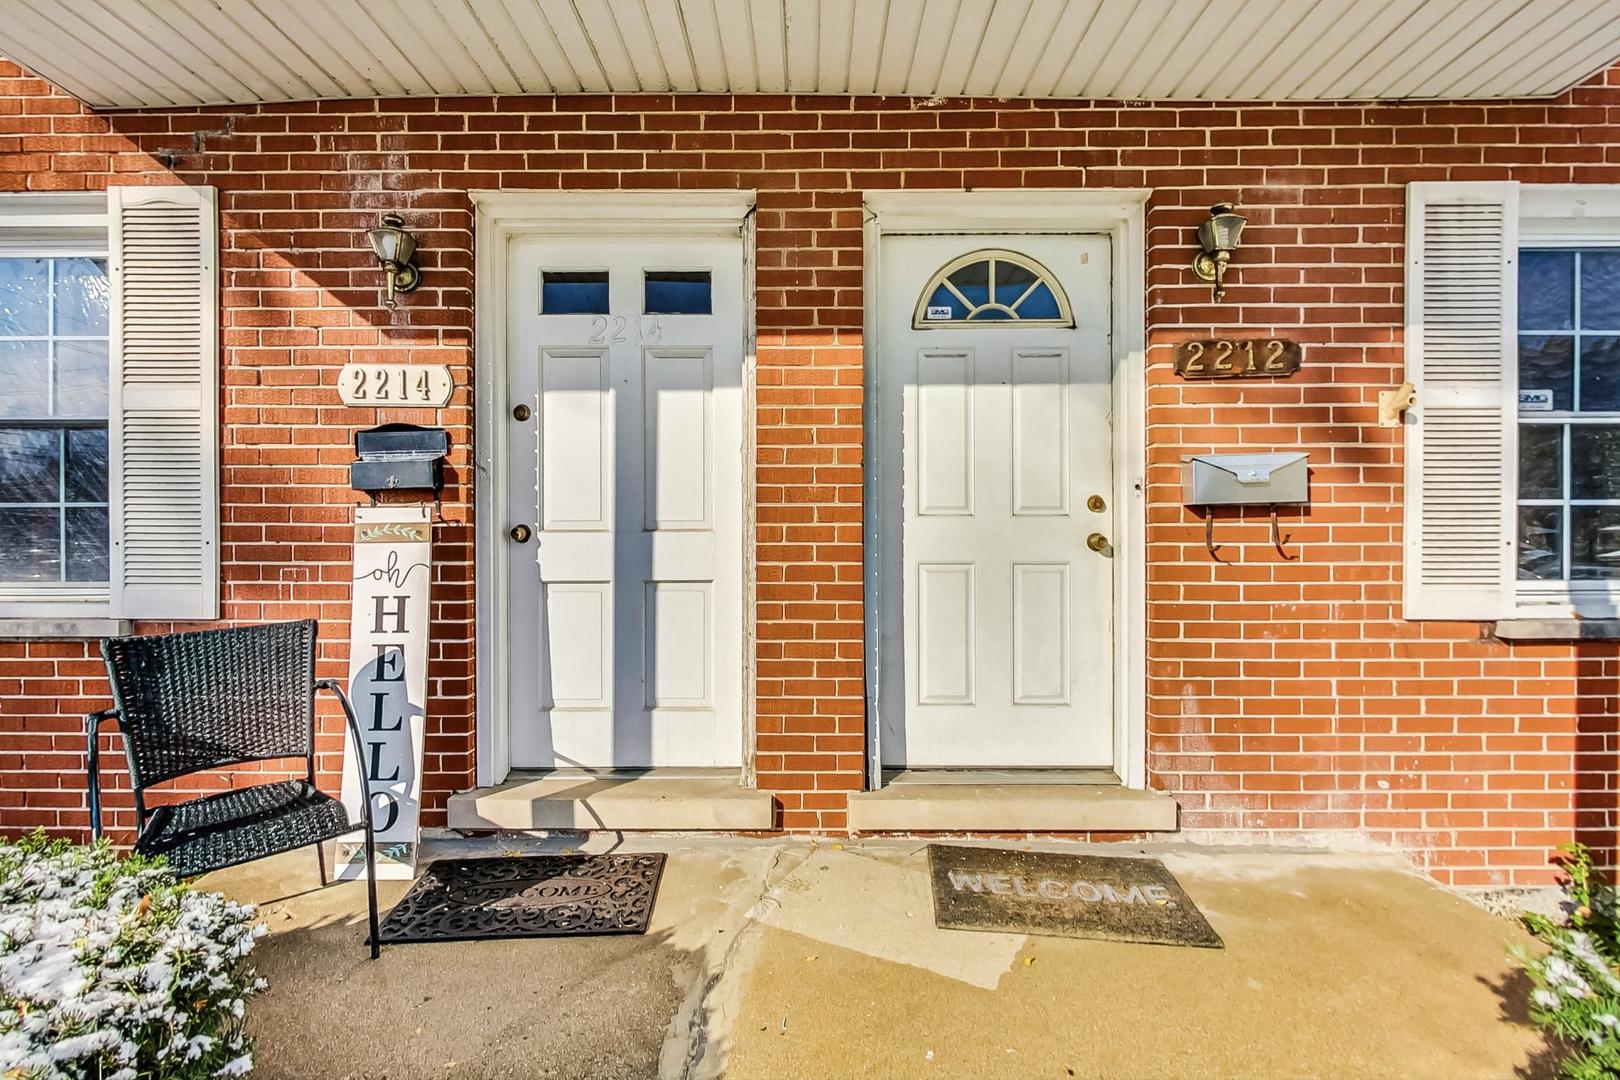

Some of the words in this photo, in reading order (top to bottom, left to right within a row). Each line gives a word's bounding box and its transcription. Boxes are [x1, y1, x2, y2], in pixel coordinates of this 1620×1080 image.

[1186, 340, 1285, 371] 2212
[352, 368, 430, 400] 2214
[354, 551, 430, 588] oh
[367, 595, 411, 833] HELLO
[464, 885, 600, 899] WELCOME
[947, 869, 1172, 907] WELCOME
